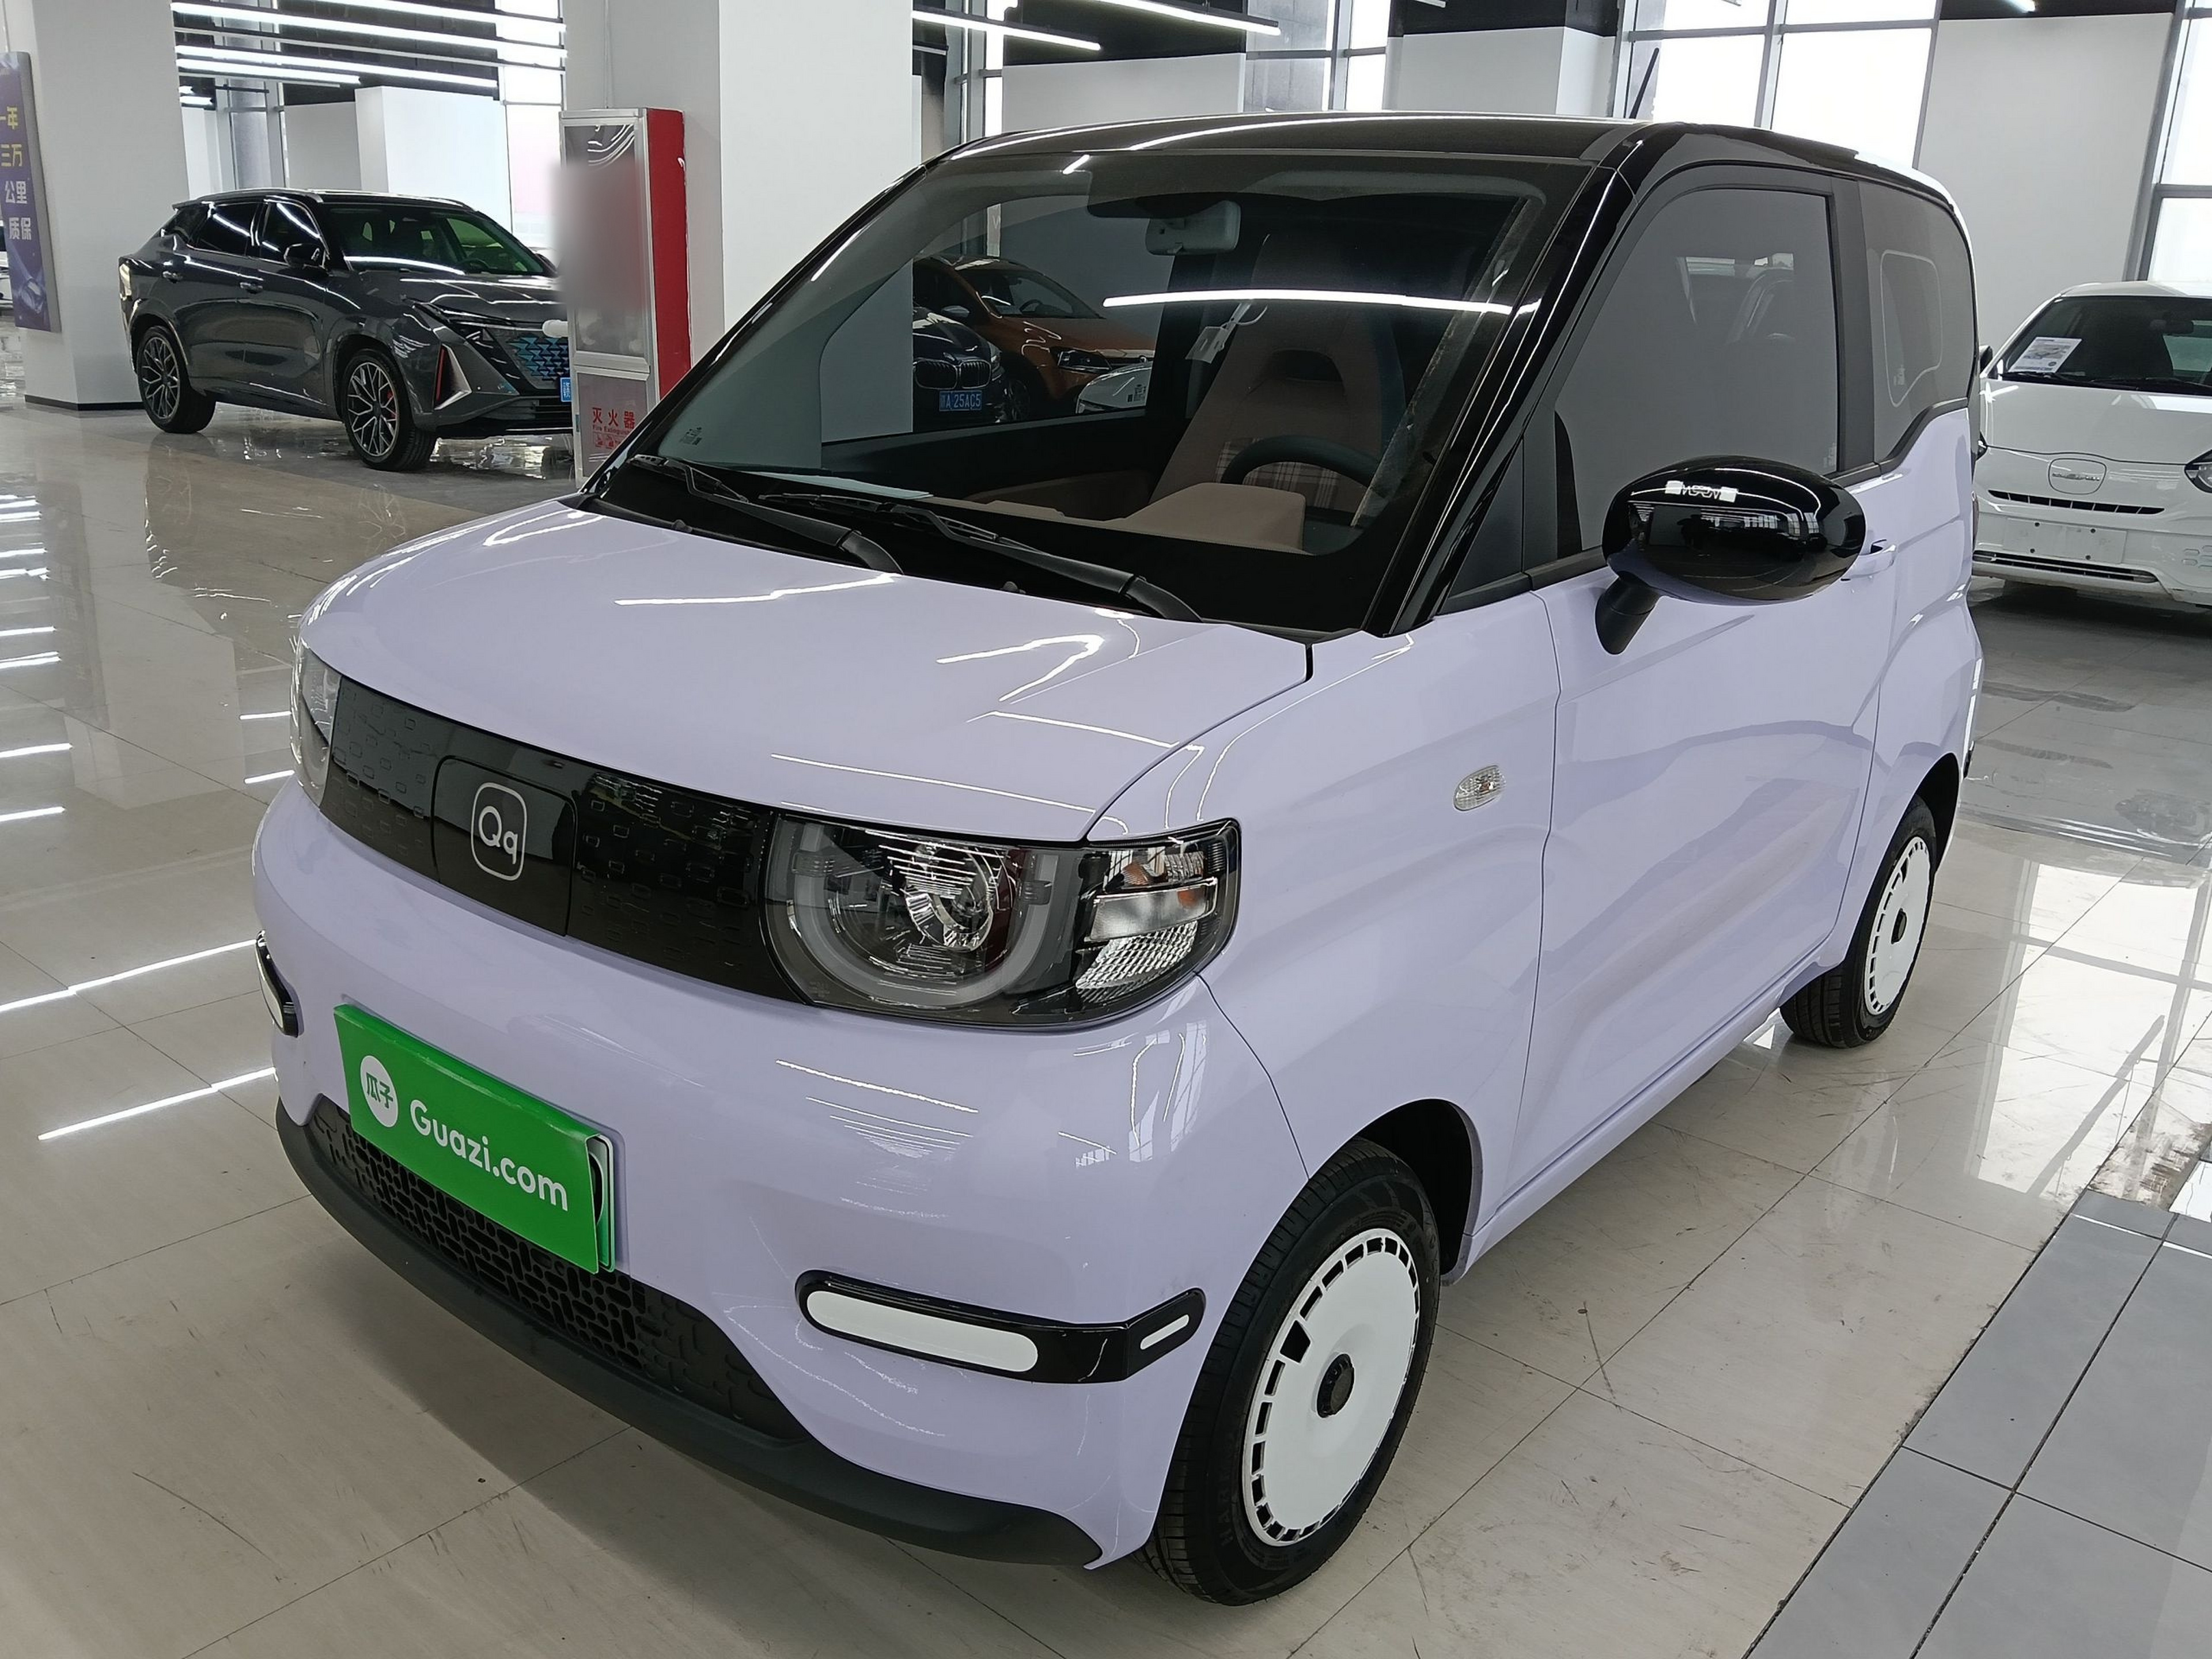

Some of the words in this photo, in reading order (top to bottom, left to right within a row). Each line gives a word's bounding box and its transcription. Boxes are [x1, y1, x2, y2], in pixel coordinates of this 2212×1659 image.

[1, 143, 22, 166] 三万
[5, 180, 28, 204] 公里
[9, 217, 32, 240] 质保
[592, 407, 635, 429] 灭火器
[479, 806, 518, 864] Qq
[366, 1072, 393, 1109] 瓜子
[410, 1100, 568, 1211] Guazi.com
